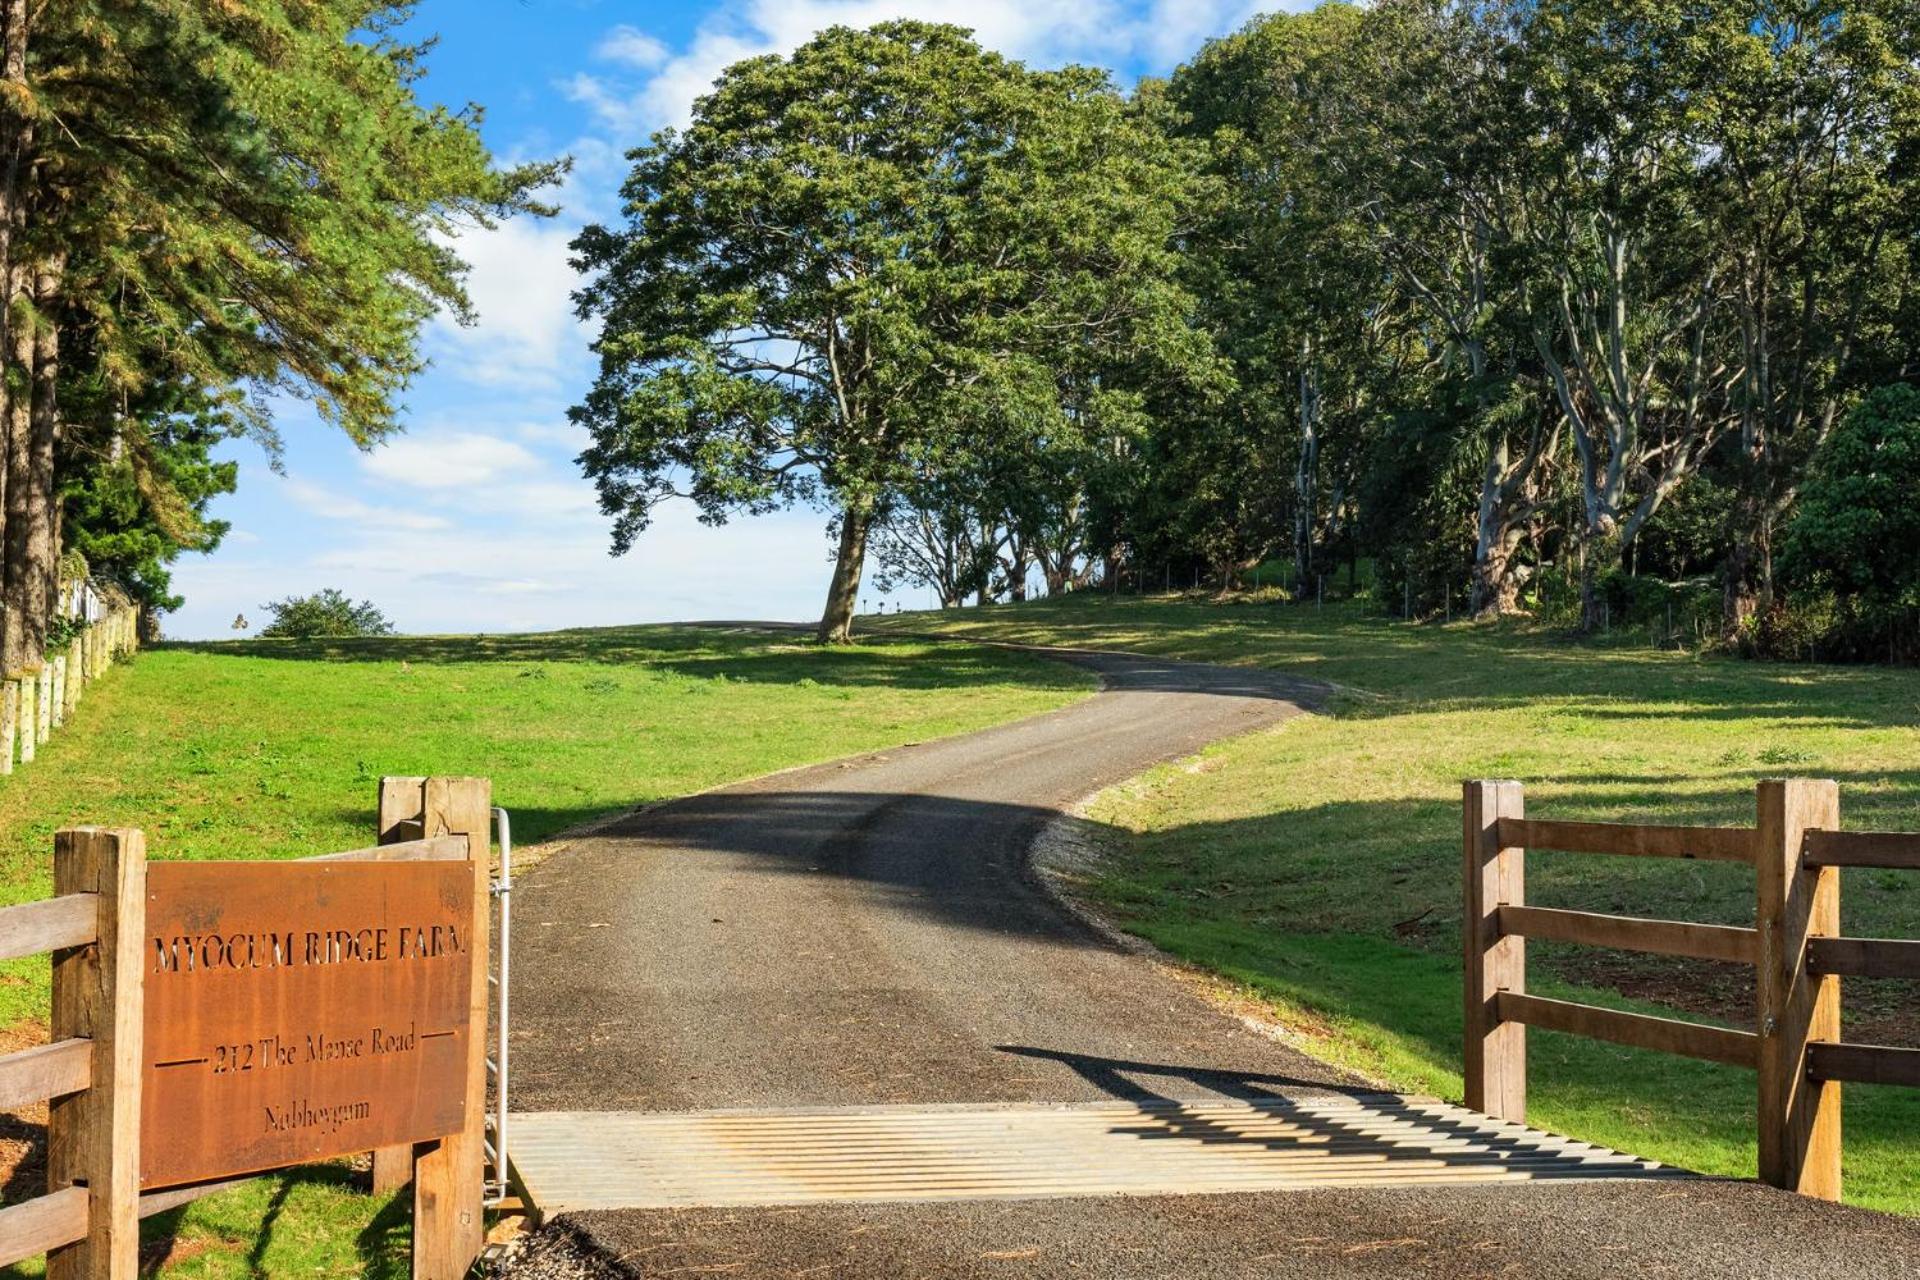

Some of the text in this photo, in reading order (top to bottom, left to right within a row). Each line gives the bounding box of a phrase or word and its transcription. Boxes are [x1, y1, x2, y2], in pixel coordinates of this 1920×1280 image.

[153, 932, 294, 973] MYOCUM
[304, 928, 388, 965] RIDGE
[213, 1043, 254, 1073] 212
[259, 1034, 297, 1069] The
[370, 1021, 415, 1056] Road
